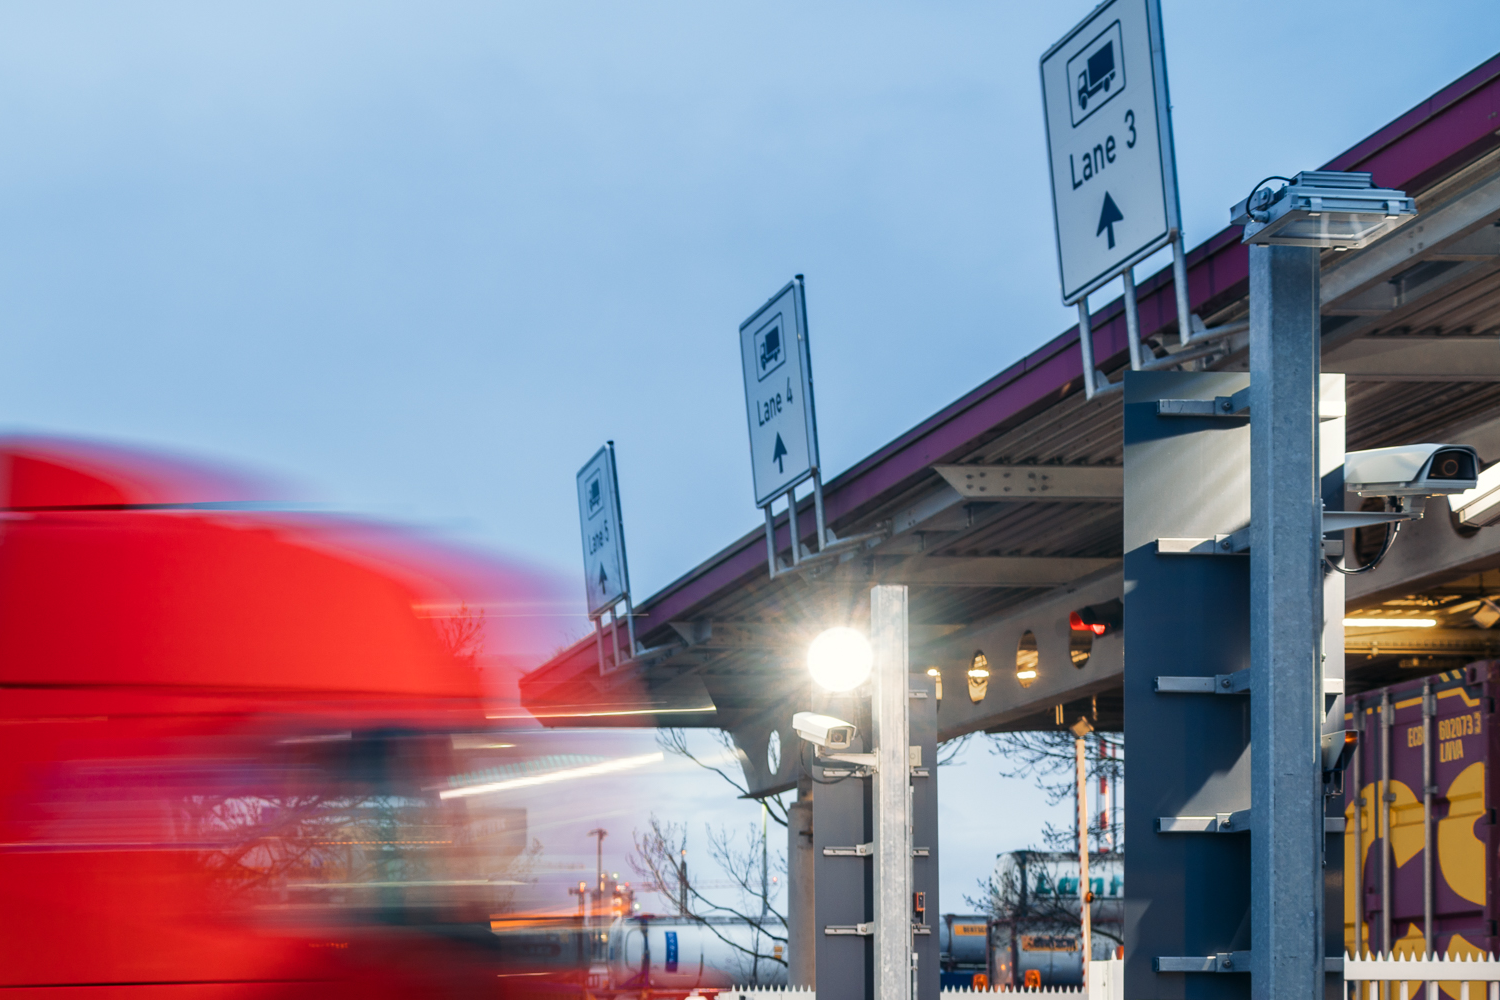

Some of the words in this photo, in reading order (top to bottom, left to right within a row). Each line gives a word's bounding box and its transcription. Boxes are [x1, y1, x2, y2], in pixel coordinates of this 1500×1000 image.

[1069, 135, 1117, 191] Lane
[1124, 109, 1137, 149] 3
[756, 392, 783, 427] Lane
[786, 376, 794, 404] 4
[587, 531, 604, 556] Lane
[604, 519, 610, 542] 5
[1407, 725, 1425, 748] ECB
[1438, 714, 1473, 740] 602073
[1473, 710, 1482, 735] 3
